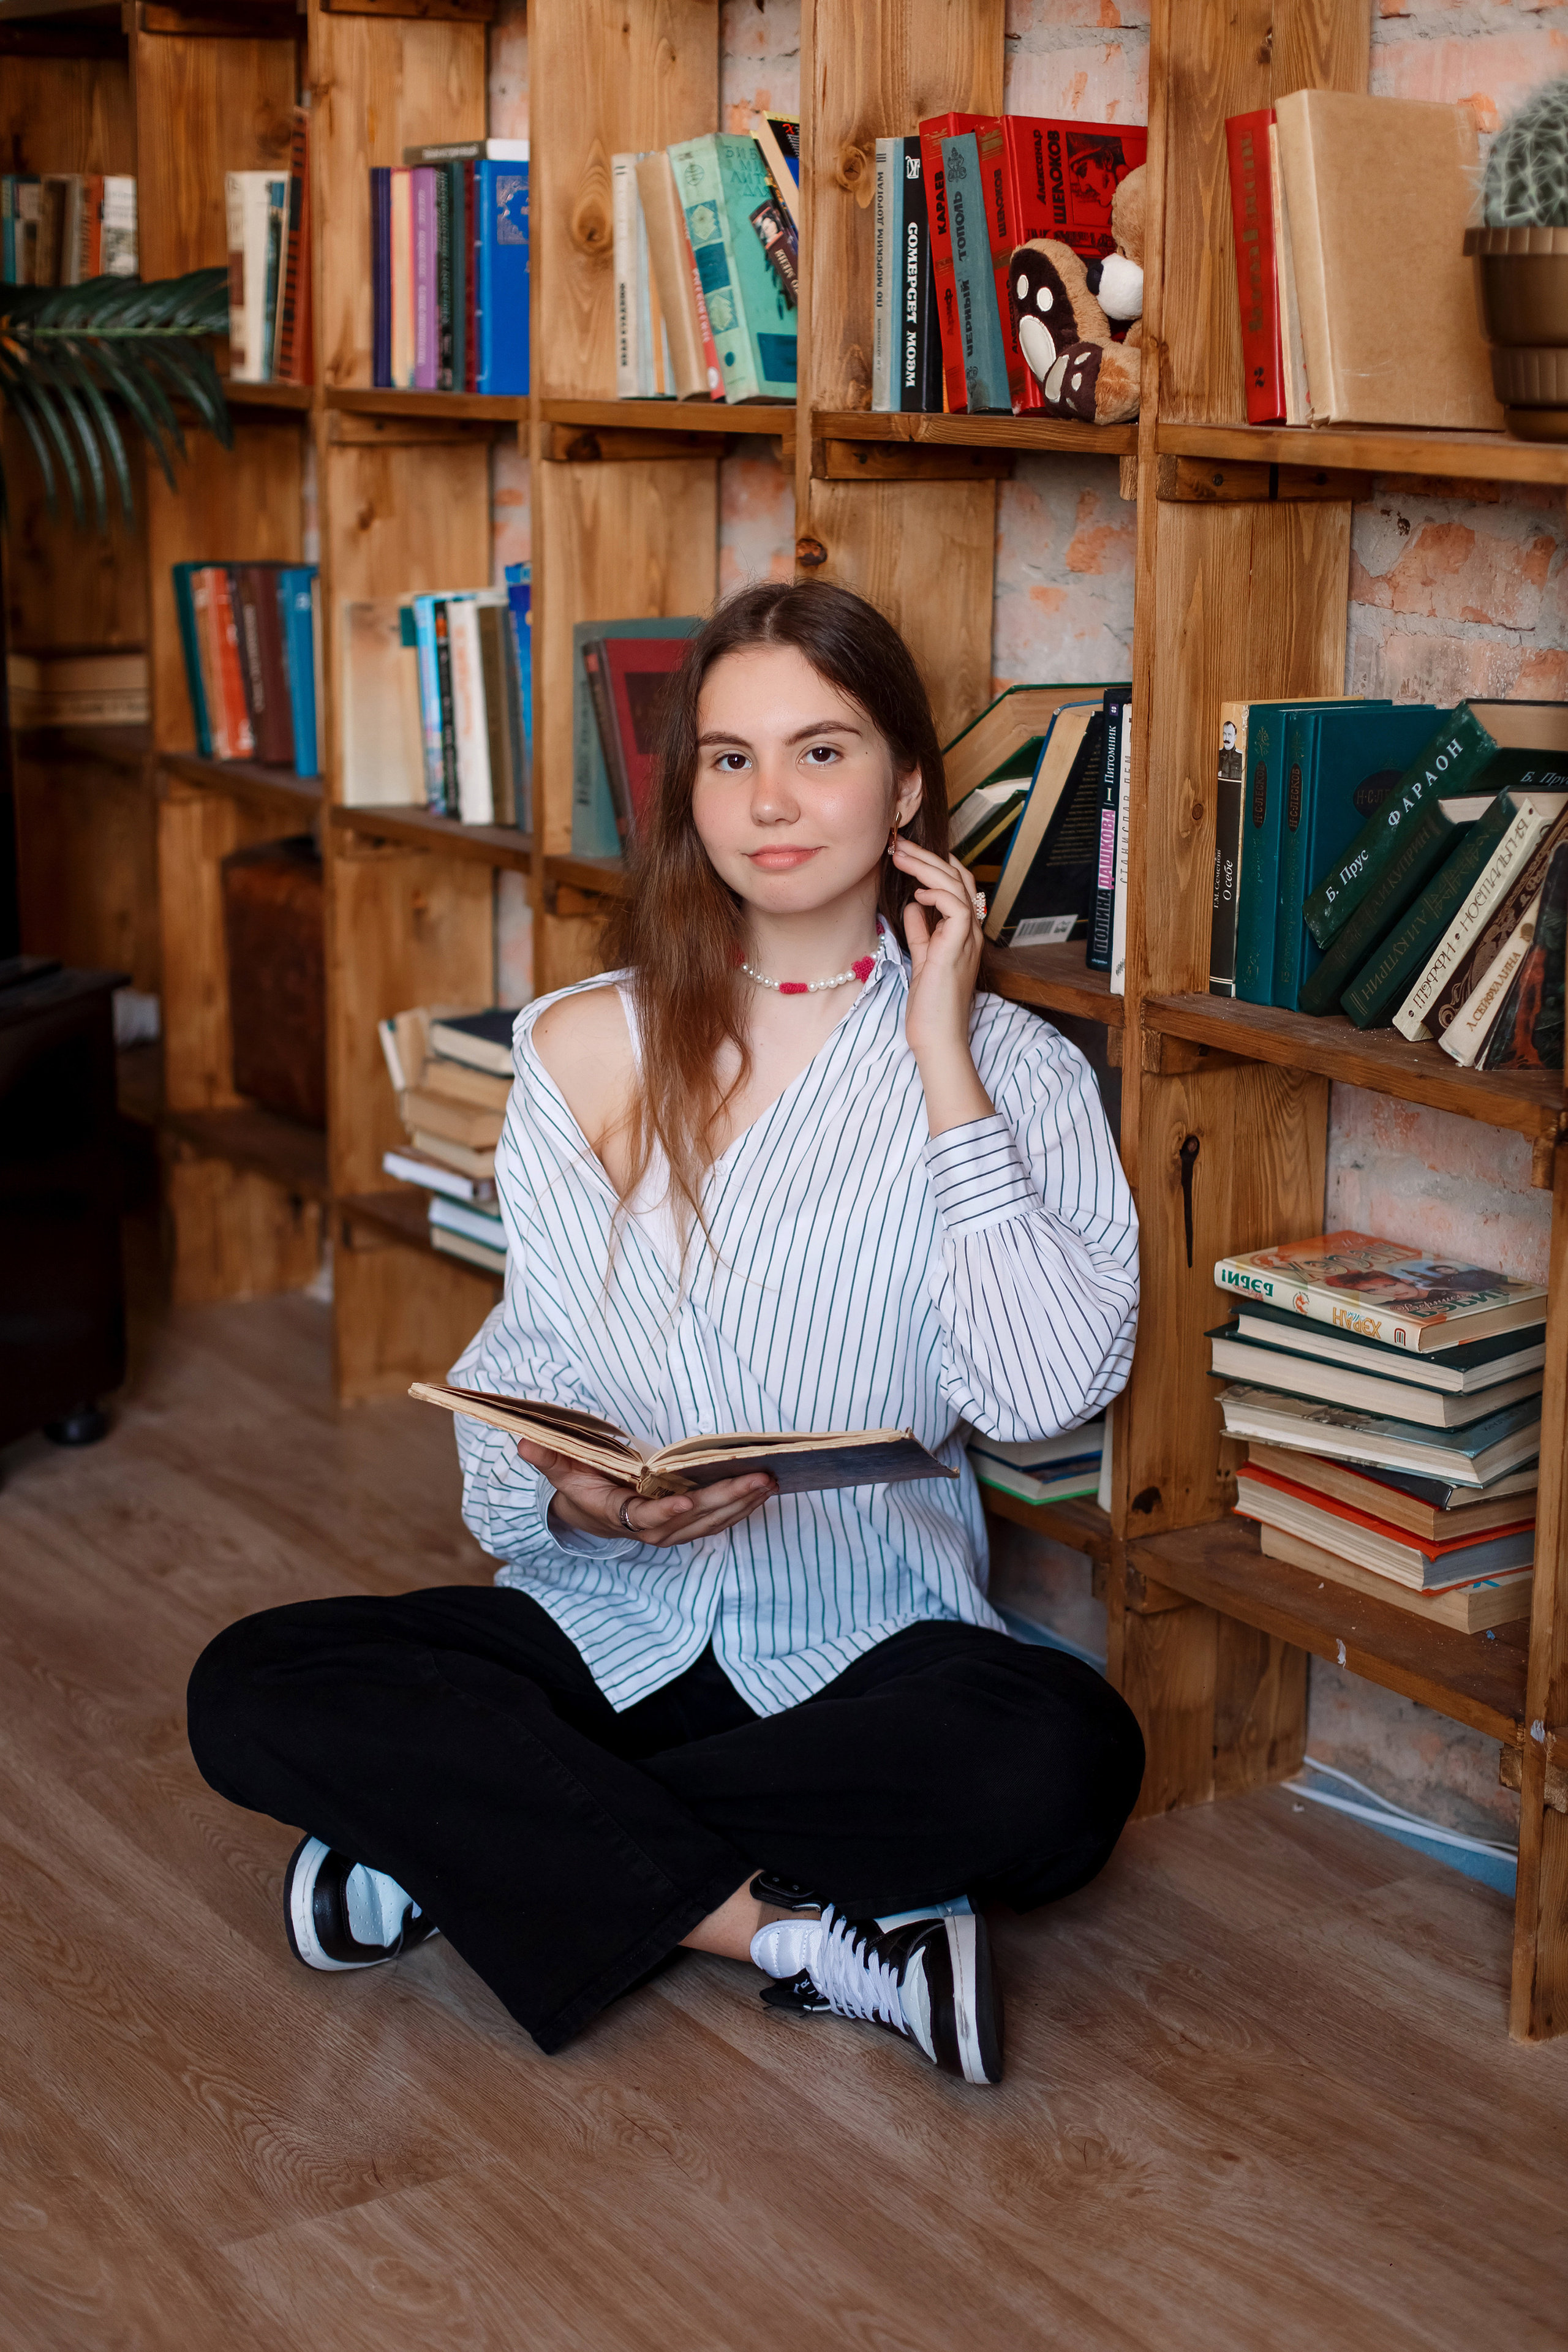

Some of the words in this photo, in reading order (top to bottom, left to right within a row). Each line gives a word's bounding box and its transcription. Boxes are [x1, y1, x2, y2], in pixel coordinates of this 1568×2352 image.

[876, 172, 885, 225] ДОРОГАМ
[934, 170, 948, 235] КАРАЕВ
[953, 191, 967, 262] ТОПОЛЬ
[876, 293, 884, 307] ПО
[906, 222, 919, 325] СОМЕРСЕТ
[960, 279, 974, 357] ЧЕРНЫЙ
[905, 330, 918, 388] МОЭМ
[1520, 771, 1536, 783] Б.
[1098, 809, 1117, 890] ДАШКОВА
[1324, 886, 1340, 903] Б.
[1338, 849, 1370, 886] Прус
[1387, 738, 1464, 827] ФАРАОН
[1224, 859, 1234, 888] себе
[1387, 827, 1431, 890] КУПРИН
[1461, 819, 1530, 932] НОСТАЛЬГИЯ
[1093, 888, 1111, 953] ПОЛИНА
[1223, 891, 1232, 901] О
[1362, 933, 1412, 1001] КУПРИН
[1220, 1267, 1274, 1298] БЭБИ!
[1332, 1306, 1382, 1340] ХЭРАН
